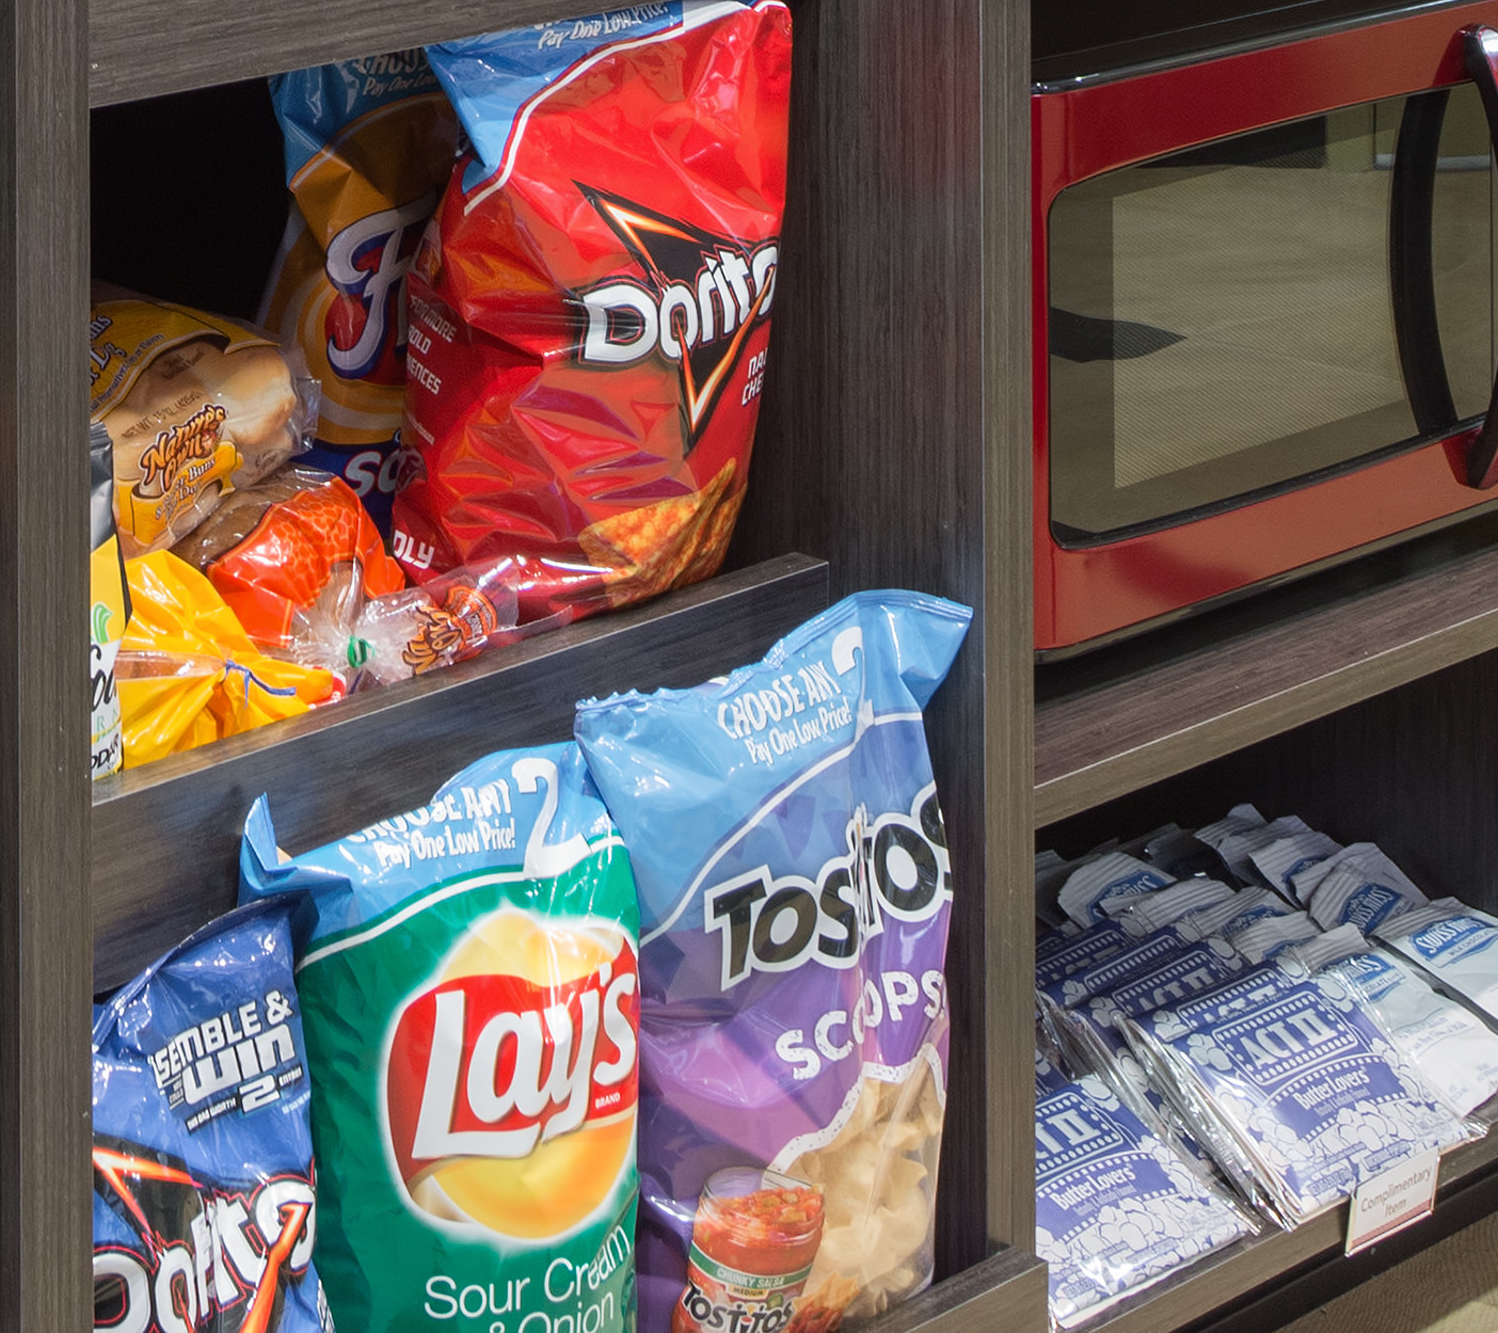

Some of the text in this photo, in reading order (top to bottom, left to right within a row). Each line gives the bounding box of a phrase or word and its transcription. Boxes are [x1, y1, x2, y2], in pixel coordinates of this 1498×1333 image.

[539, 27, 571, 50] Pay
[717, 674, 804, 741] CHOOSE
[745, 717, 820, 765] Pay Low
[412, 816, 517, 862] One Low Price!
[182, 1023, 295, 1105] WIN
[414, 963, 636, 1161] Lay's
[595, 1092, 621, 1110] BRAND
[1360, 1165, 1433, 1213] Complimentary
[1384, 1198, 1407, 1218] Item
[424, 1226, 632, 1321] Sour Cream
